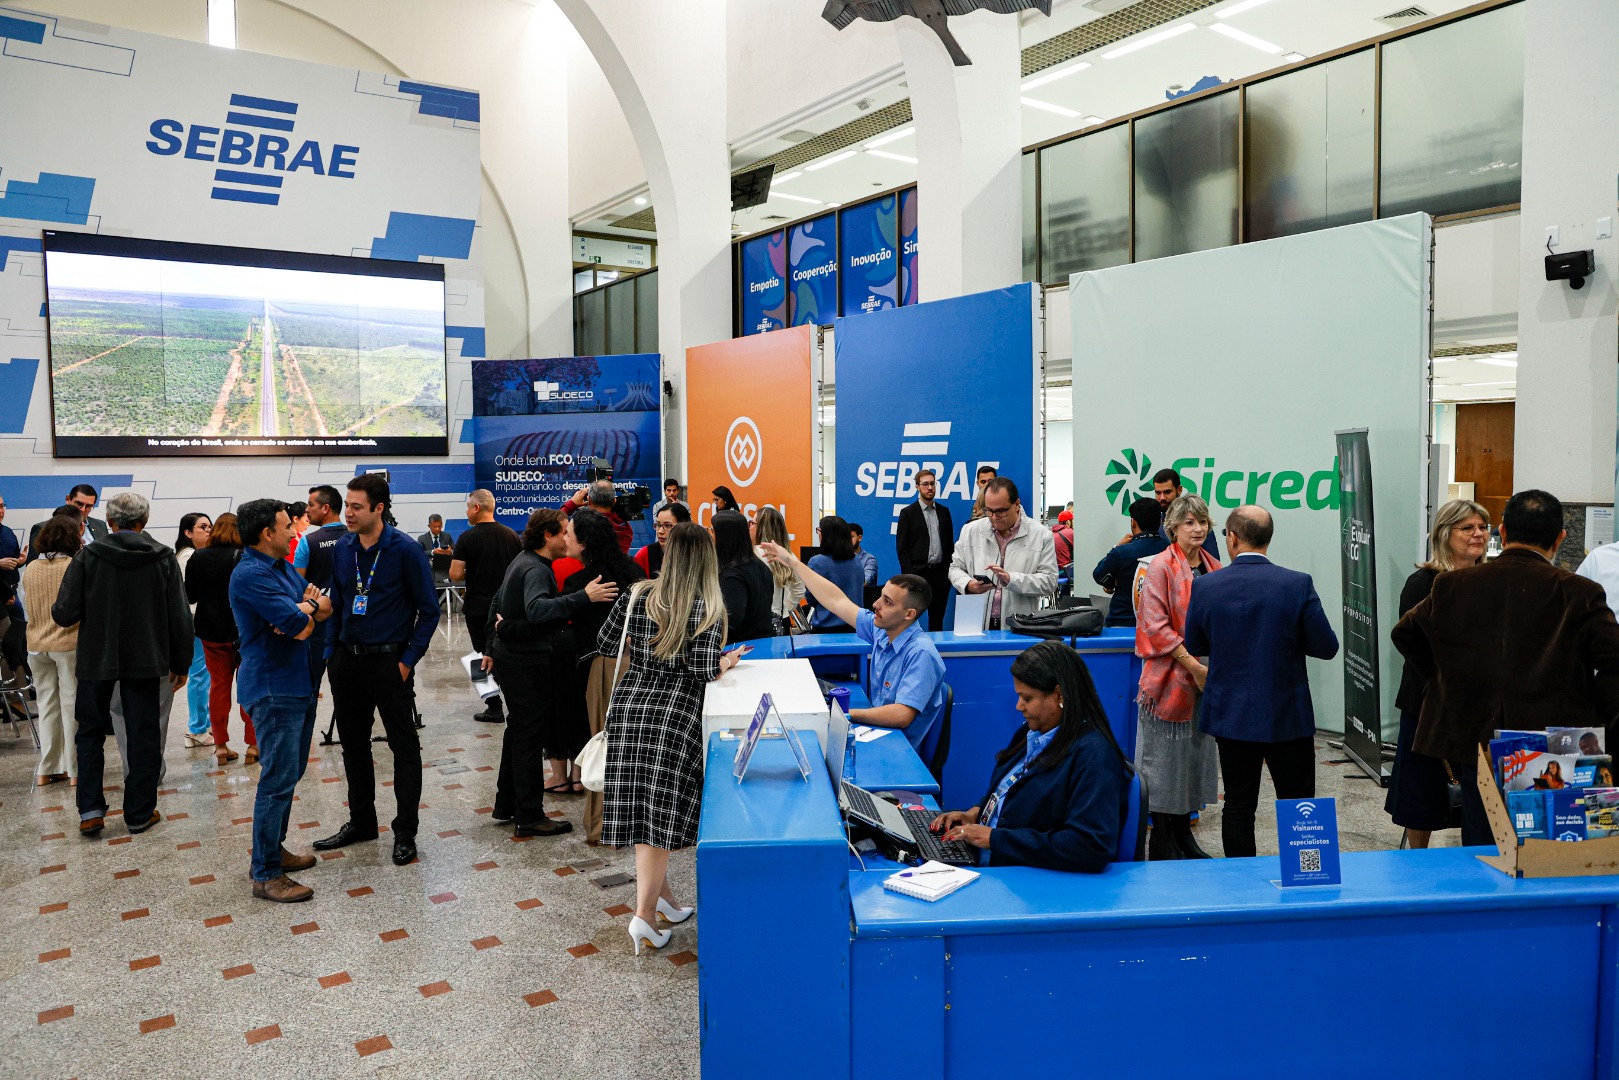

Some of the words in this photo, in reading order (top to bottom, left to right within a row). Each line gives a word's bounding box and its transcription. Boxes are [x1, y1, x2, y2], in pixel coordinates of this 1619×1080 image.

[145, 118, 360, 179] SEBRAE
[851, 247, 892, 267] Inovação
[750, 276, 779, 293] Empatia
[550, 390, 593, 399] SUDECO
[494, 454, 524, 466] Onde
[526, 455, 546, 466] tem
[549, 453, 575, 466] FCO,
[495, 471, 545, 482] SUDECO:
[495, 481, 553, 493] Impulsionando
[502, 494, 560, 505] oportunidades
[1289, 839, 1330, 847] especialistas
